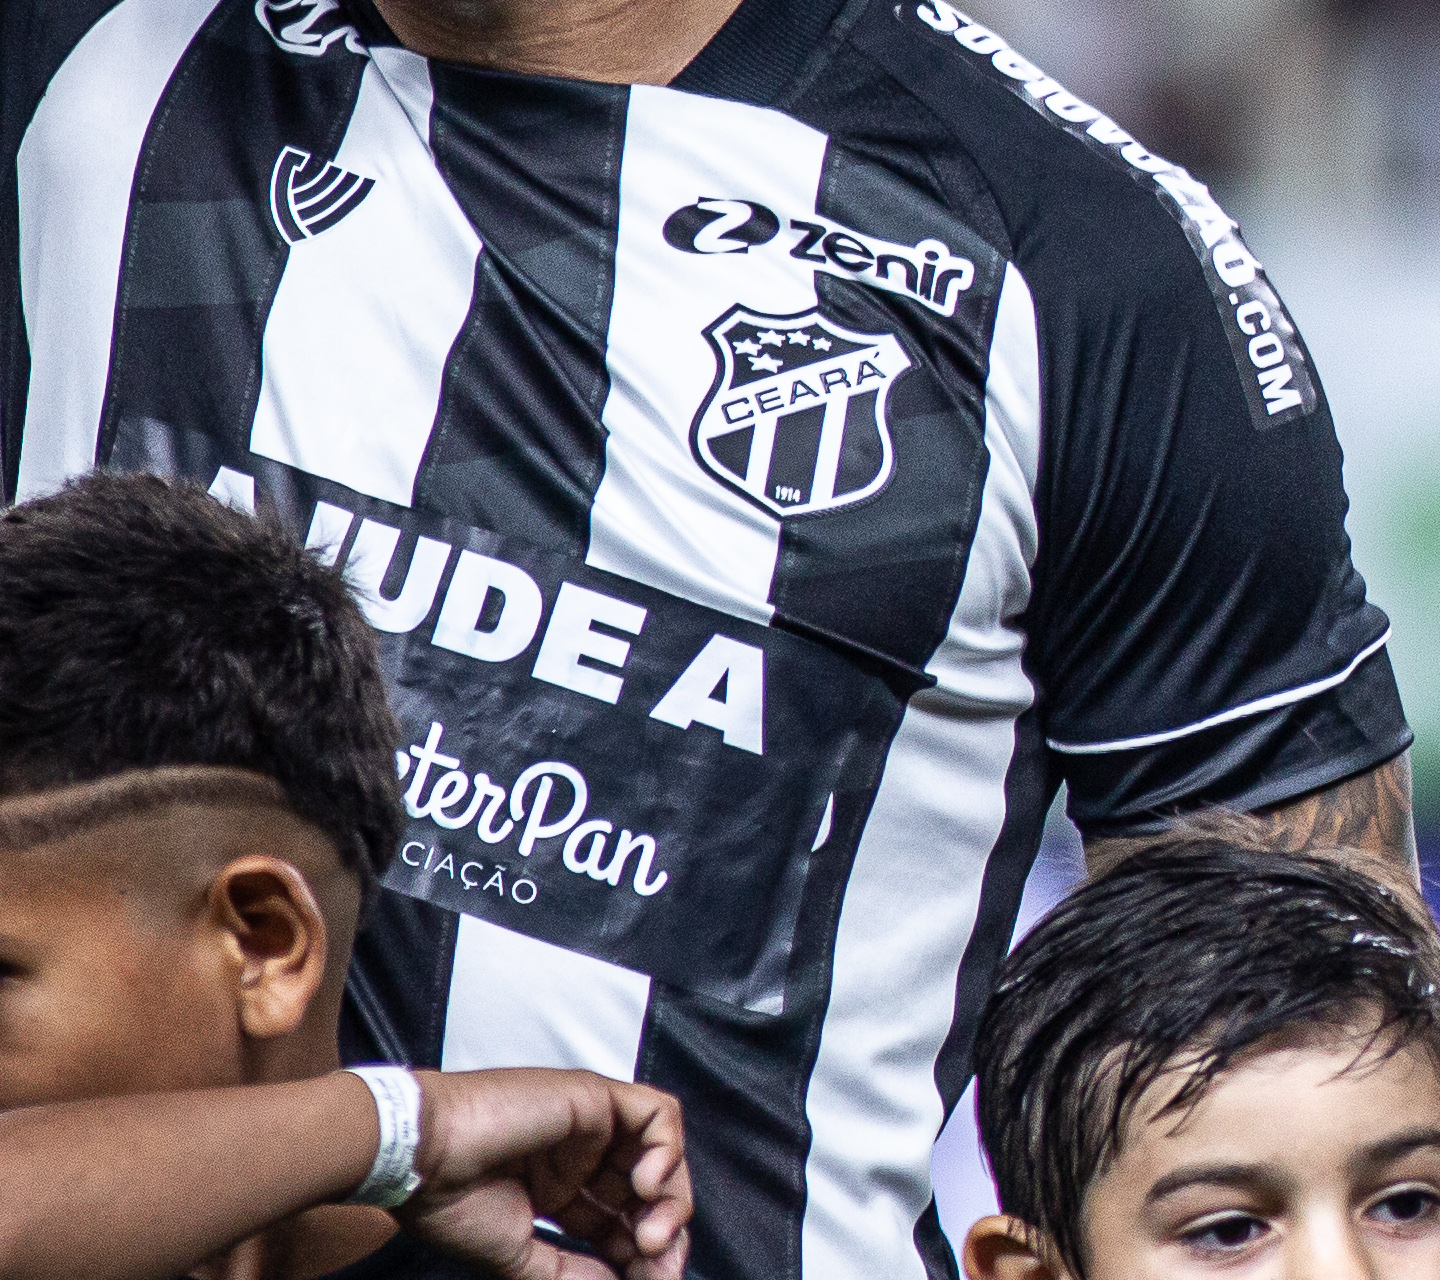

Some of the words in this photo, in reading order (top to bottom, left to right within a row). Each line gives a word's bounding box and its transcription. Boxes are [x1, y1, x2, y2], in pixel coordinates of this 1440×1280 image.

[788, 218, 964, 307] zenir
[720, 350, 888, 425] CEARÁ
[774, 484, 802, 504] 1914
[206, 465, 648, 705] UDE
[648, 632, 764, 756] A
[396, 720, 668, 897] terPan
[400, 840, 539, 907] CIAÇÃO
